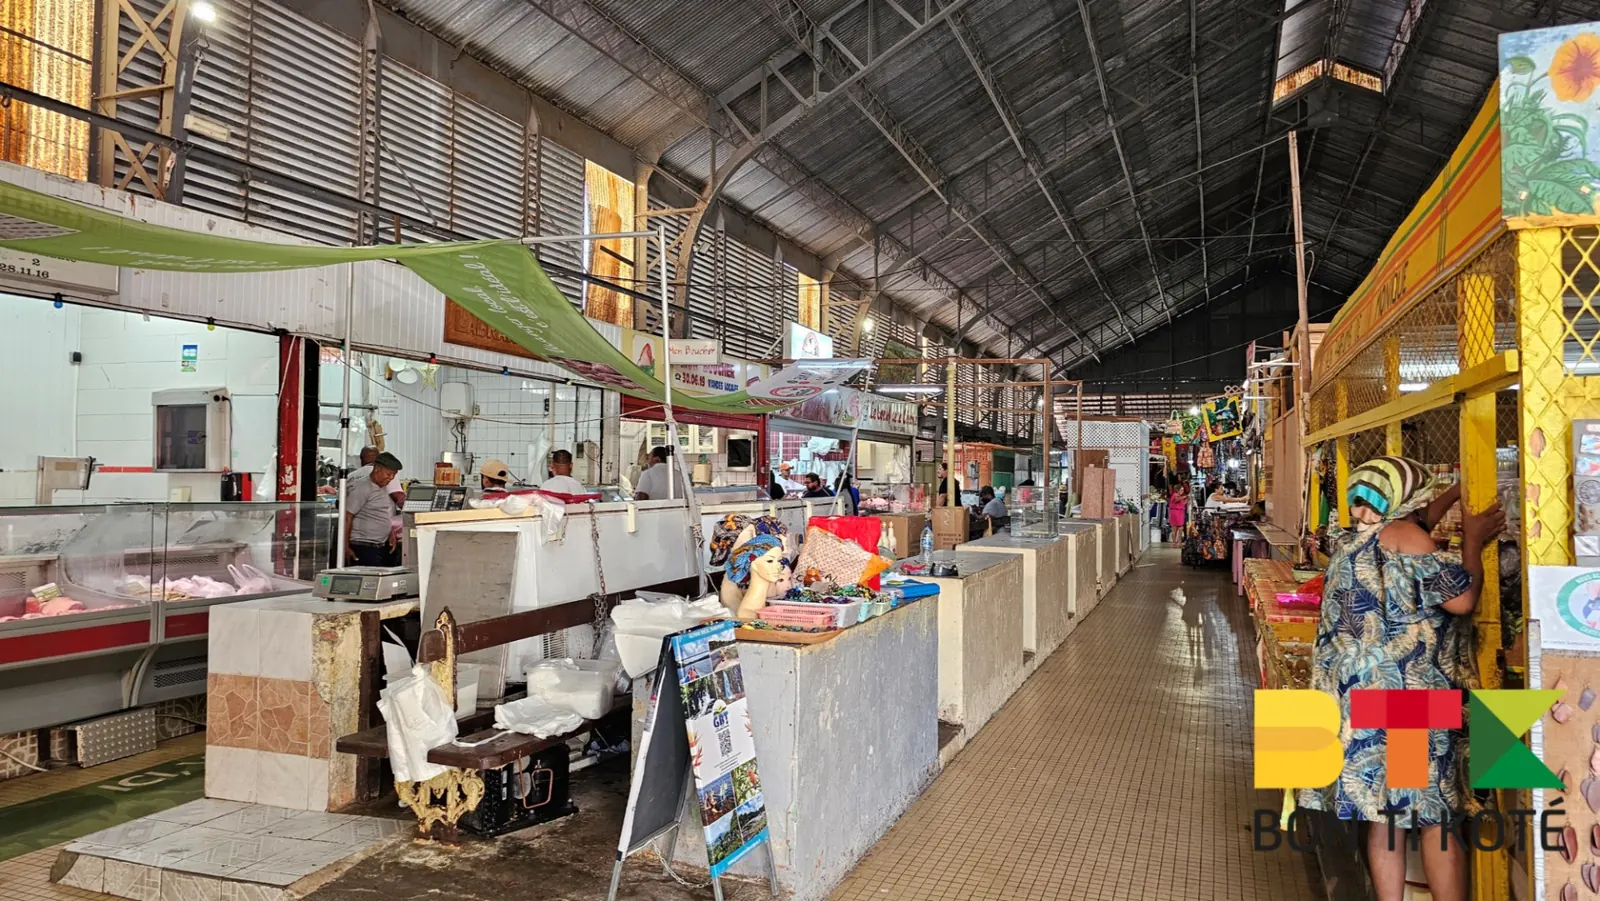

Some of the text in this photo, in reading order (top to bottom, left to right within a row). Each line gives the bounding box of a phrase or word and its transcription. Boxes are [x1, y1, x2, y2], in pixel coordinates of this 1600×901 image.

[685, 345, 716, 356] Boucher
[682, 371, 706, 387] 30.06.19
[712, 711, 729, 729] GBT
